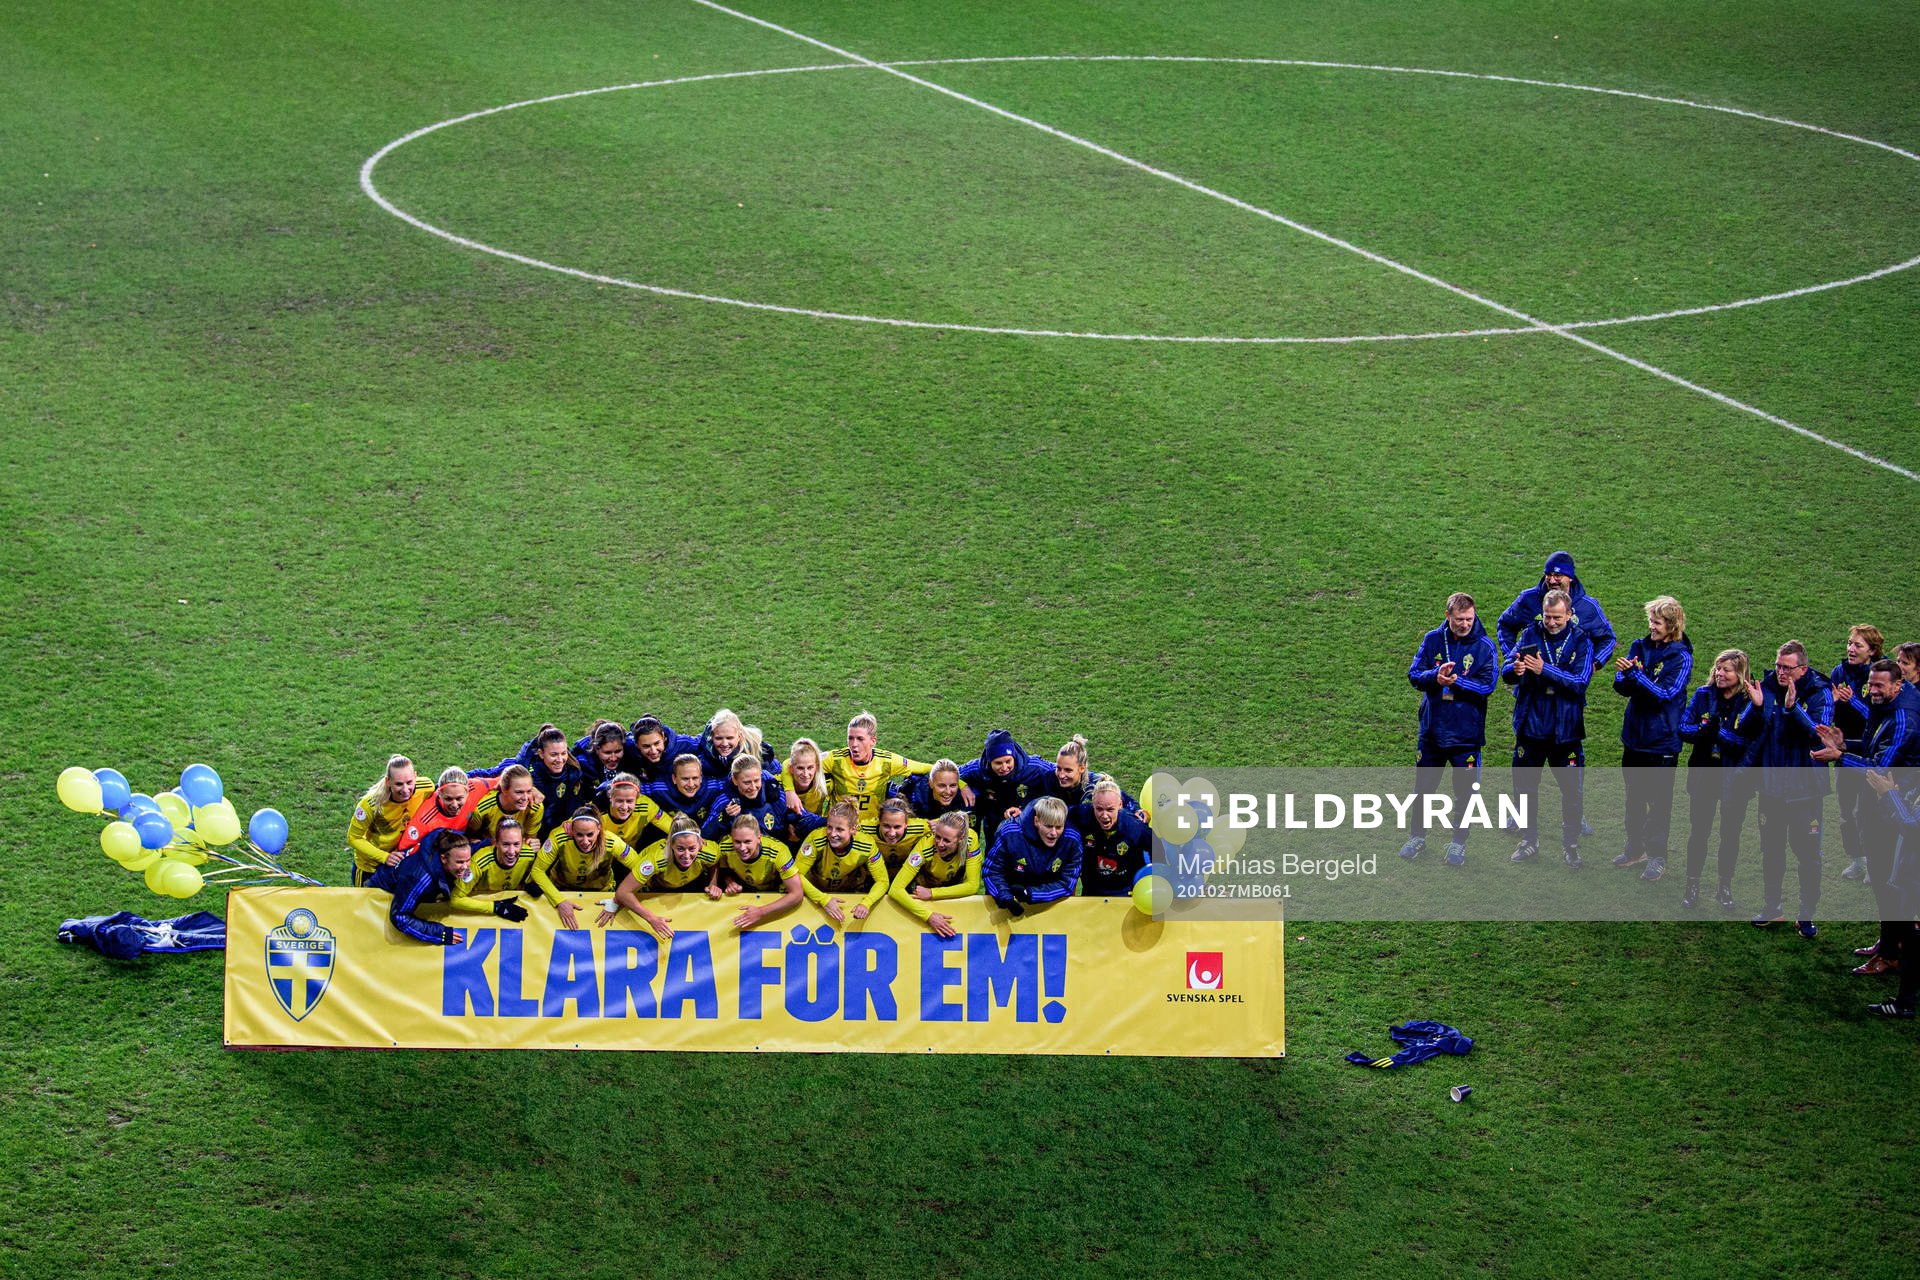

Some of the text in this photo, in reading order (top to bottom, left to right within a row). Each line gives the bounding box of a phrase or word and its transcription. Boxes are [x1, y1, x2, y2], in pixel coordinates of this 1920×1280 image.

[275, 941, 325, 950] SVERIGE
[442, 923, 1067, 1024] KLARA FÖR EM!
[1167, 993, 1244, 1003] SVENSKA SPEL
